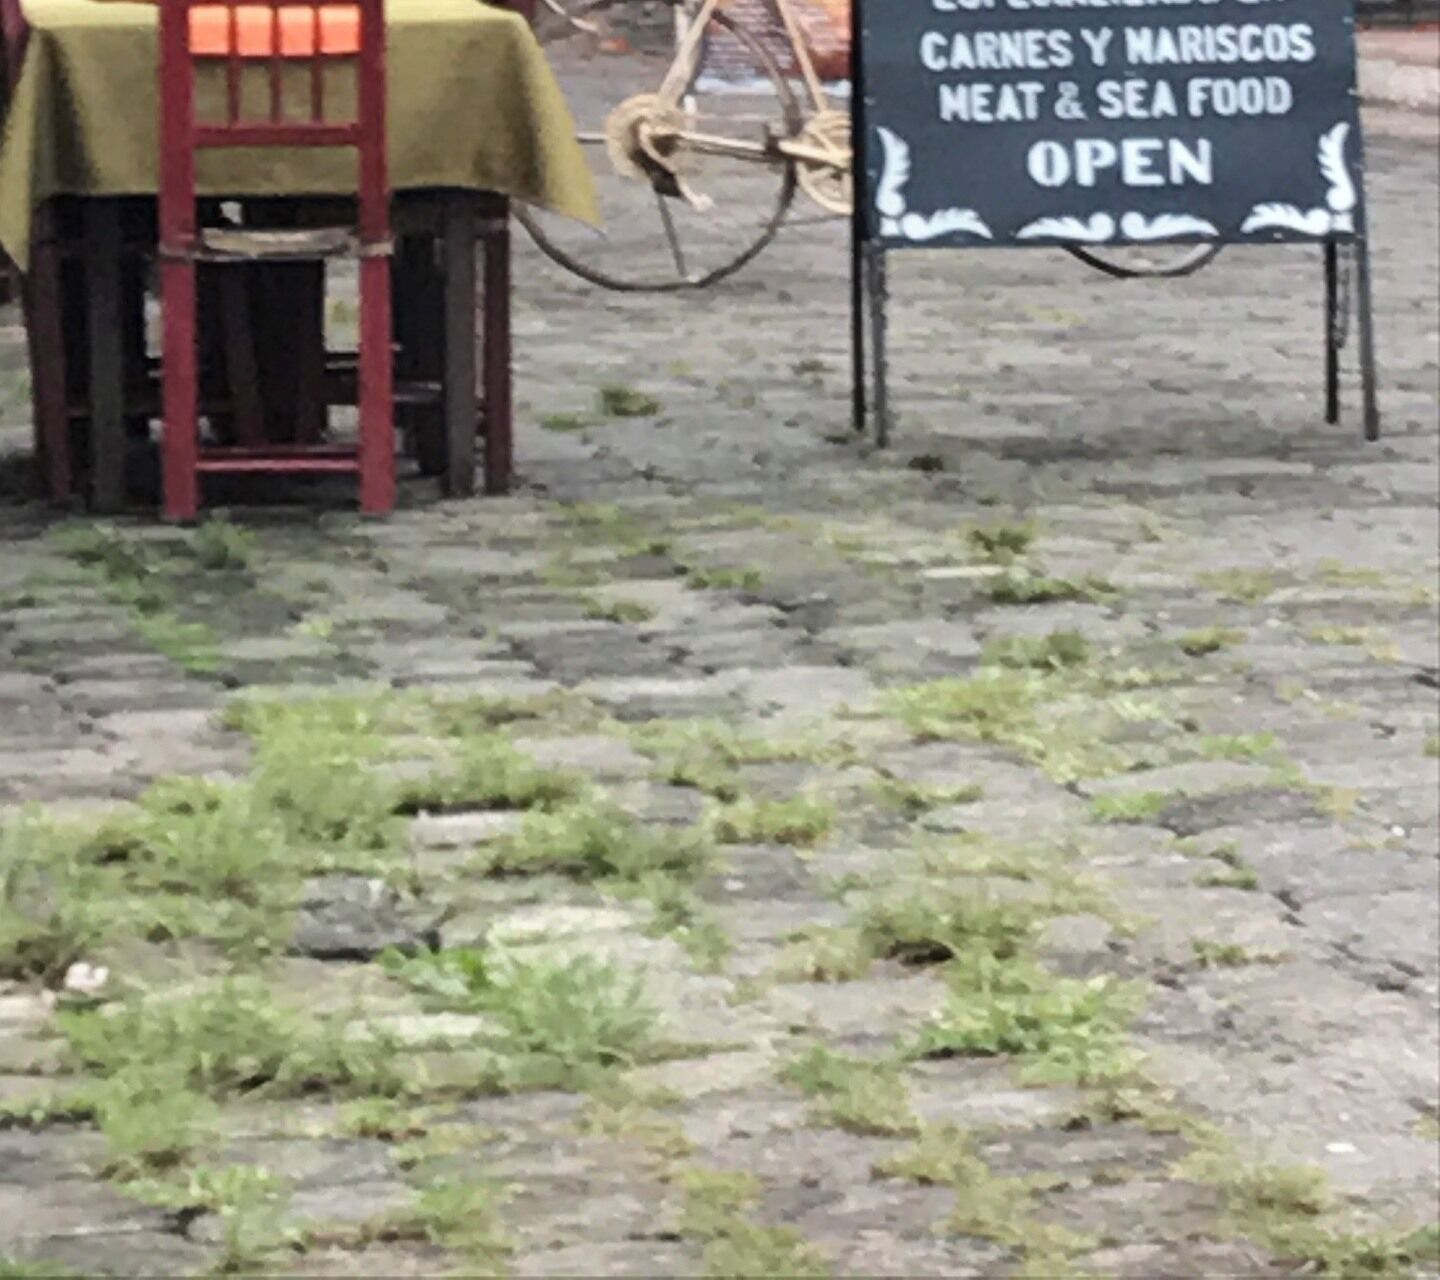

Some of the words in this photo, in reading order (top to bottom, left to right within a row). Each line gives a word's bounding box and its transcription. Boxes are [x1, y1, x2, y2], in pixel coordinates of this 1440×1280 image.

[919, 28, 1075, 72] CARNES
[1080, 26, 1114, 67] Y
[1123, 22, 1316, 65] MARISCOS
[939, 81, 1045, 123] MEAT
[1054, 81, 1087, 120] &
[1096, 78, 1178, 119] SEA
[1187, 76, 1293, 117] FOOD
[1027, 137, 1213, 187] OPEN
